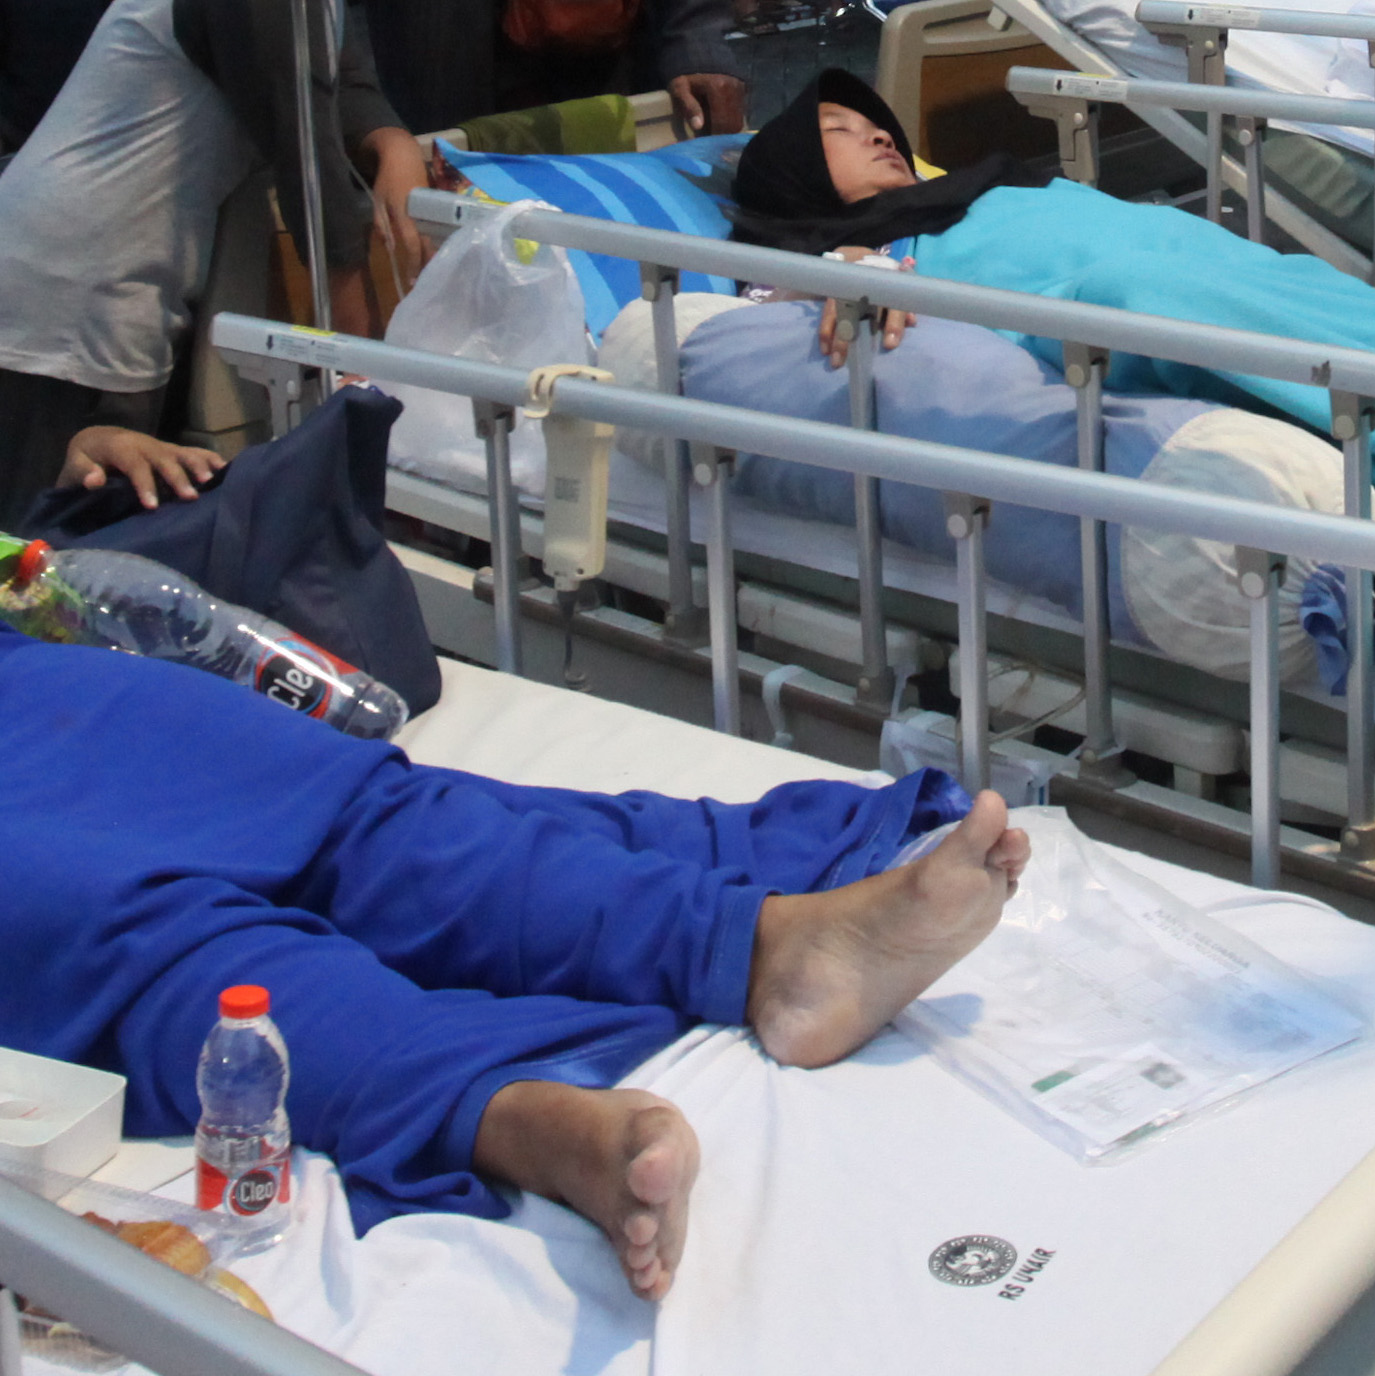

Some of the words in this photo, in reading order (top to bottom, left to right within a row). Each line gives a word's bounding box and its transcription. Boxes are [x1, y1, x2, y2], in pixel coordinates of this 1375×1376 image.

[266, 667, 314, 711] Cle
[239, 1180, 274, 1203] Cleo
[998, 1283, 1026, 1301] RS
[1012, 1247, 1057, 1283] UNAIR
